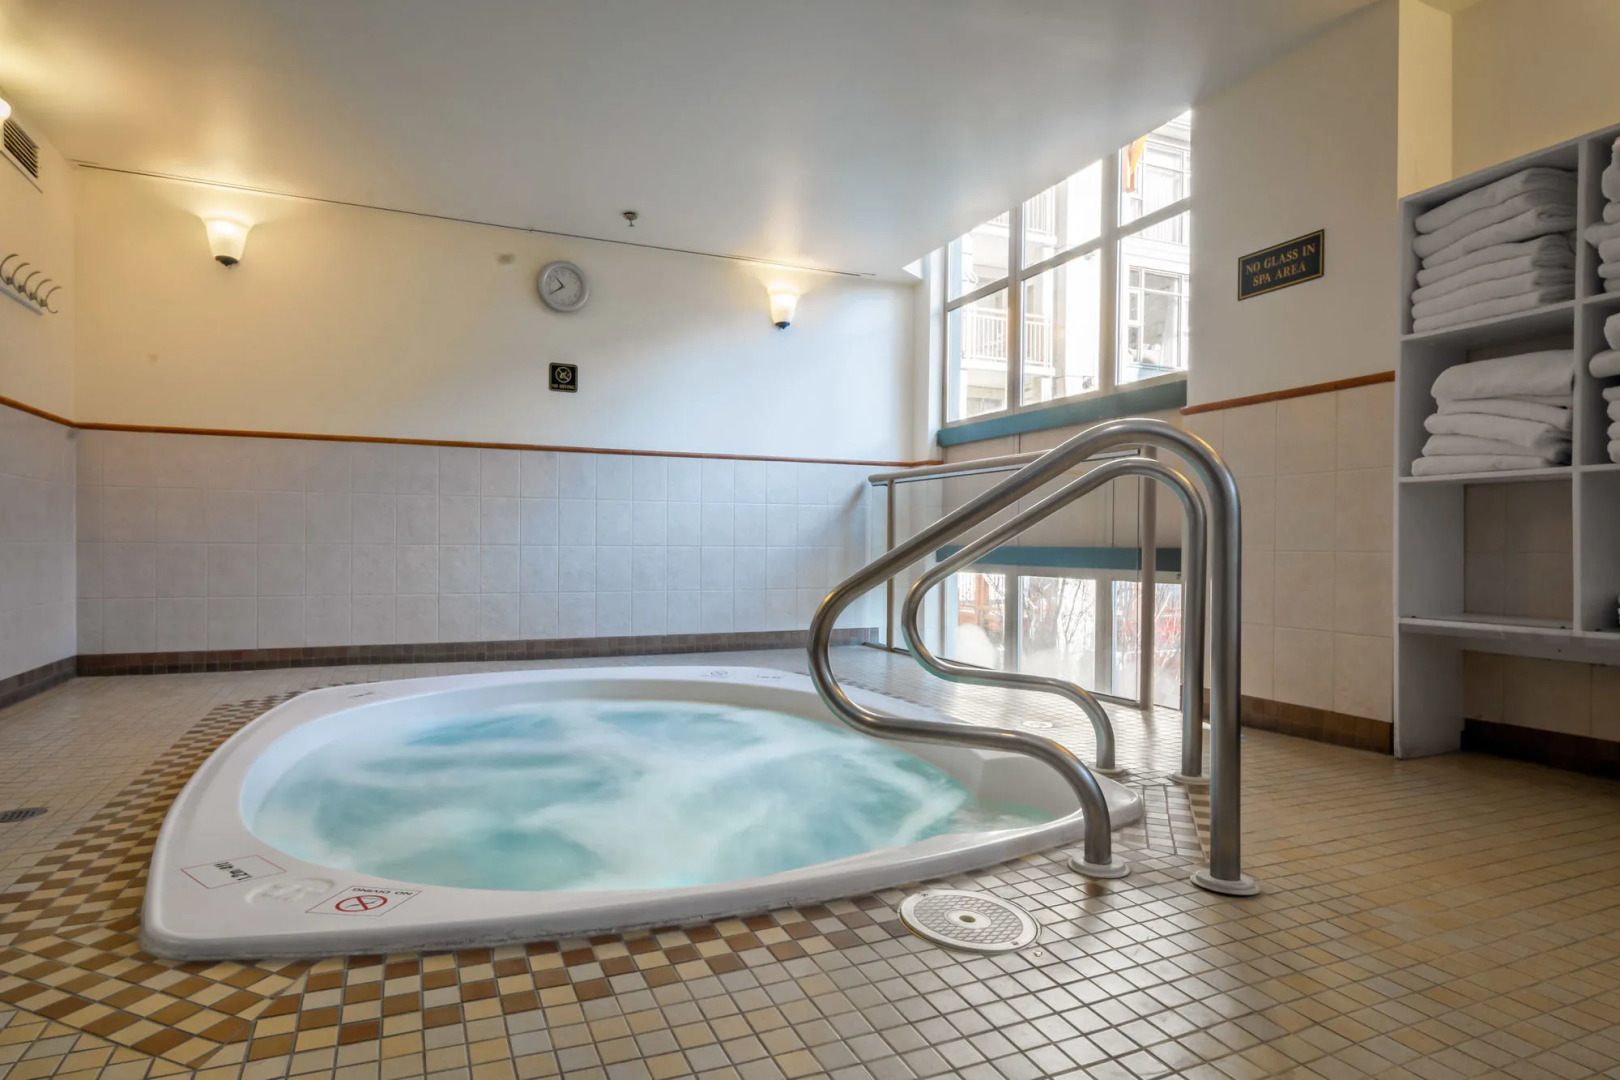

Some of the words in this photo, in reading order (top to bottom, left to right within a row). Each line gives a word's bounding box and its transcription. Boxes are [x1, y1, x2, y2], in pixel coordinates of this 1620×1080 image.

[1246, 261, 1261, 275] NO
[1264, 248, 1299, 268] GLASS
[1302, 243, 1316, 257] IN
[1253, 272, 1271, 286] SPA
[1275, 261, 1306, 280] AREA
[352, 887, 391, 895] DIVING
